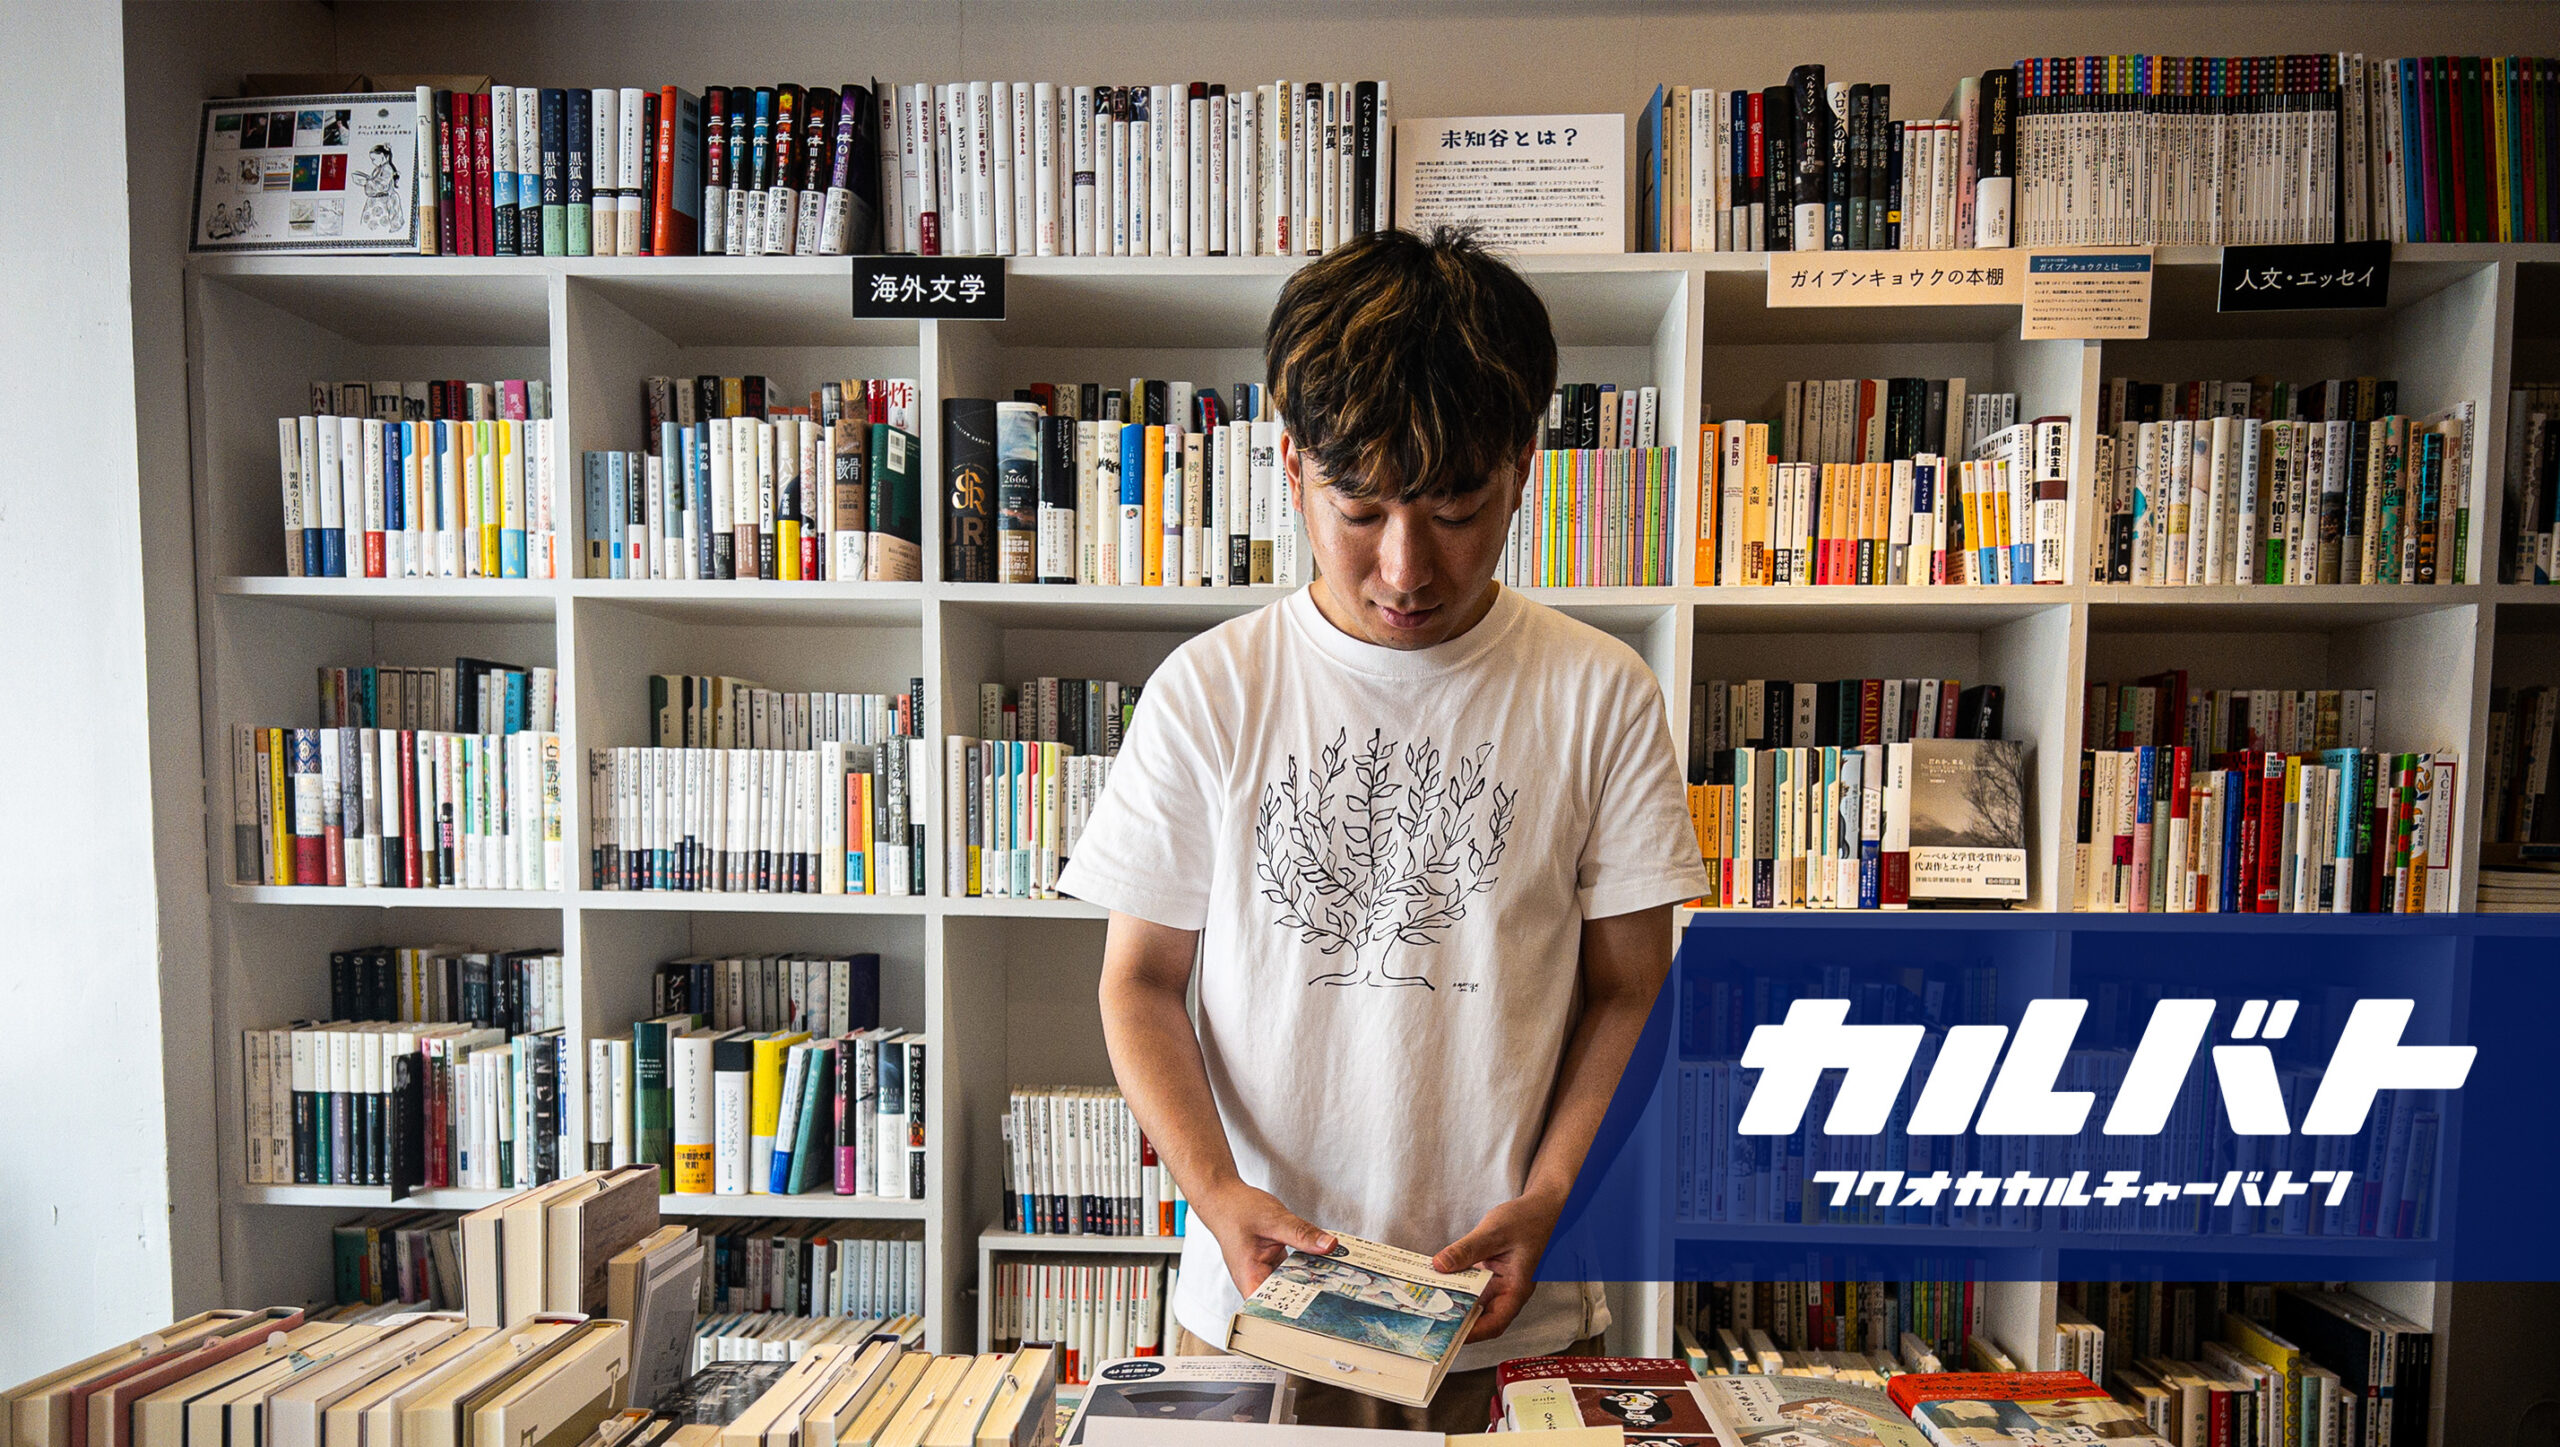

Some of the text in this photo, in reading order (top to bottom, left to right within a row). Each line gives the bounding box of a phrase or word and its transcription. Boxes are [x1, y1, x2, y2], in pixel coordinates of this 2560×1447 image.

[938, 102, 947, 136] 犬と負け犬
[1244, 109, 1253, 128] 不死
[1992, 75, 2008, 136] 中上健次論
[706, 115, 724, 145] 三体
[905, 102, 913, 155] ロサンゼルスへの道
[1325, 125, 1337, 150] 所長
[1440, 128, 1579, 150] 未知谷とは？
[1719, 122, 1730, 145] 家族
[1734, 120, 1746, 132] 性
[1751, 122, 1762, 135] 愛
[1806, 73, 1816, 174] ベルクソン 反時代的哲学
[1832, 90, 1847, 168] バロックの哲学
[455, 126, 471, 178] 雪を待つ
[474, 127, 489, 179] 雪を待つ
[1775, 139, 1786, 193] 生ける物質
[543, 152, 558, 202] 黒狐の谷
[569, 152, 583, 202] 黒狐の谷
[871, 273, 986, 304] 海外文学
[1789, 267, 2005, 289] ガイブンキョウクの本棚
[2235, 266, 2375, 291] 人文・エッセイ
[953, 420, 971, 437] WILLIAM
[1582, 402, 1595, 447] レモン
[700, 443, 709, 471] 雨の島
[1971, 432, 2013, 460] THE UNDYING
[2050, 426, 2062, 478] 新自由主義
[836, 457, 861, 481] 骸骨
[1004, 474, 1028, 485] 2666
[2309, 436, 2323, 515] 植物考 藤原辰史
[1188, 462, 1199, 528] 続けてみます
[1108, 714, 1121, 751] NICKEL
[544, 744, 559, 798] 亡霊の地
[2441, 768, 2450, 802] ACE
[443, 823, 453, 849] BEBE
[1914, 862, 1982, 873] 代表作とエッセイ
[1915, 851, 2022, 864] ノーベル文学賞受賞作家の
[2411, 865, 2424, 907] 烈女の一生
[910, 1046, 921, 1125] 魅せられた旅人
